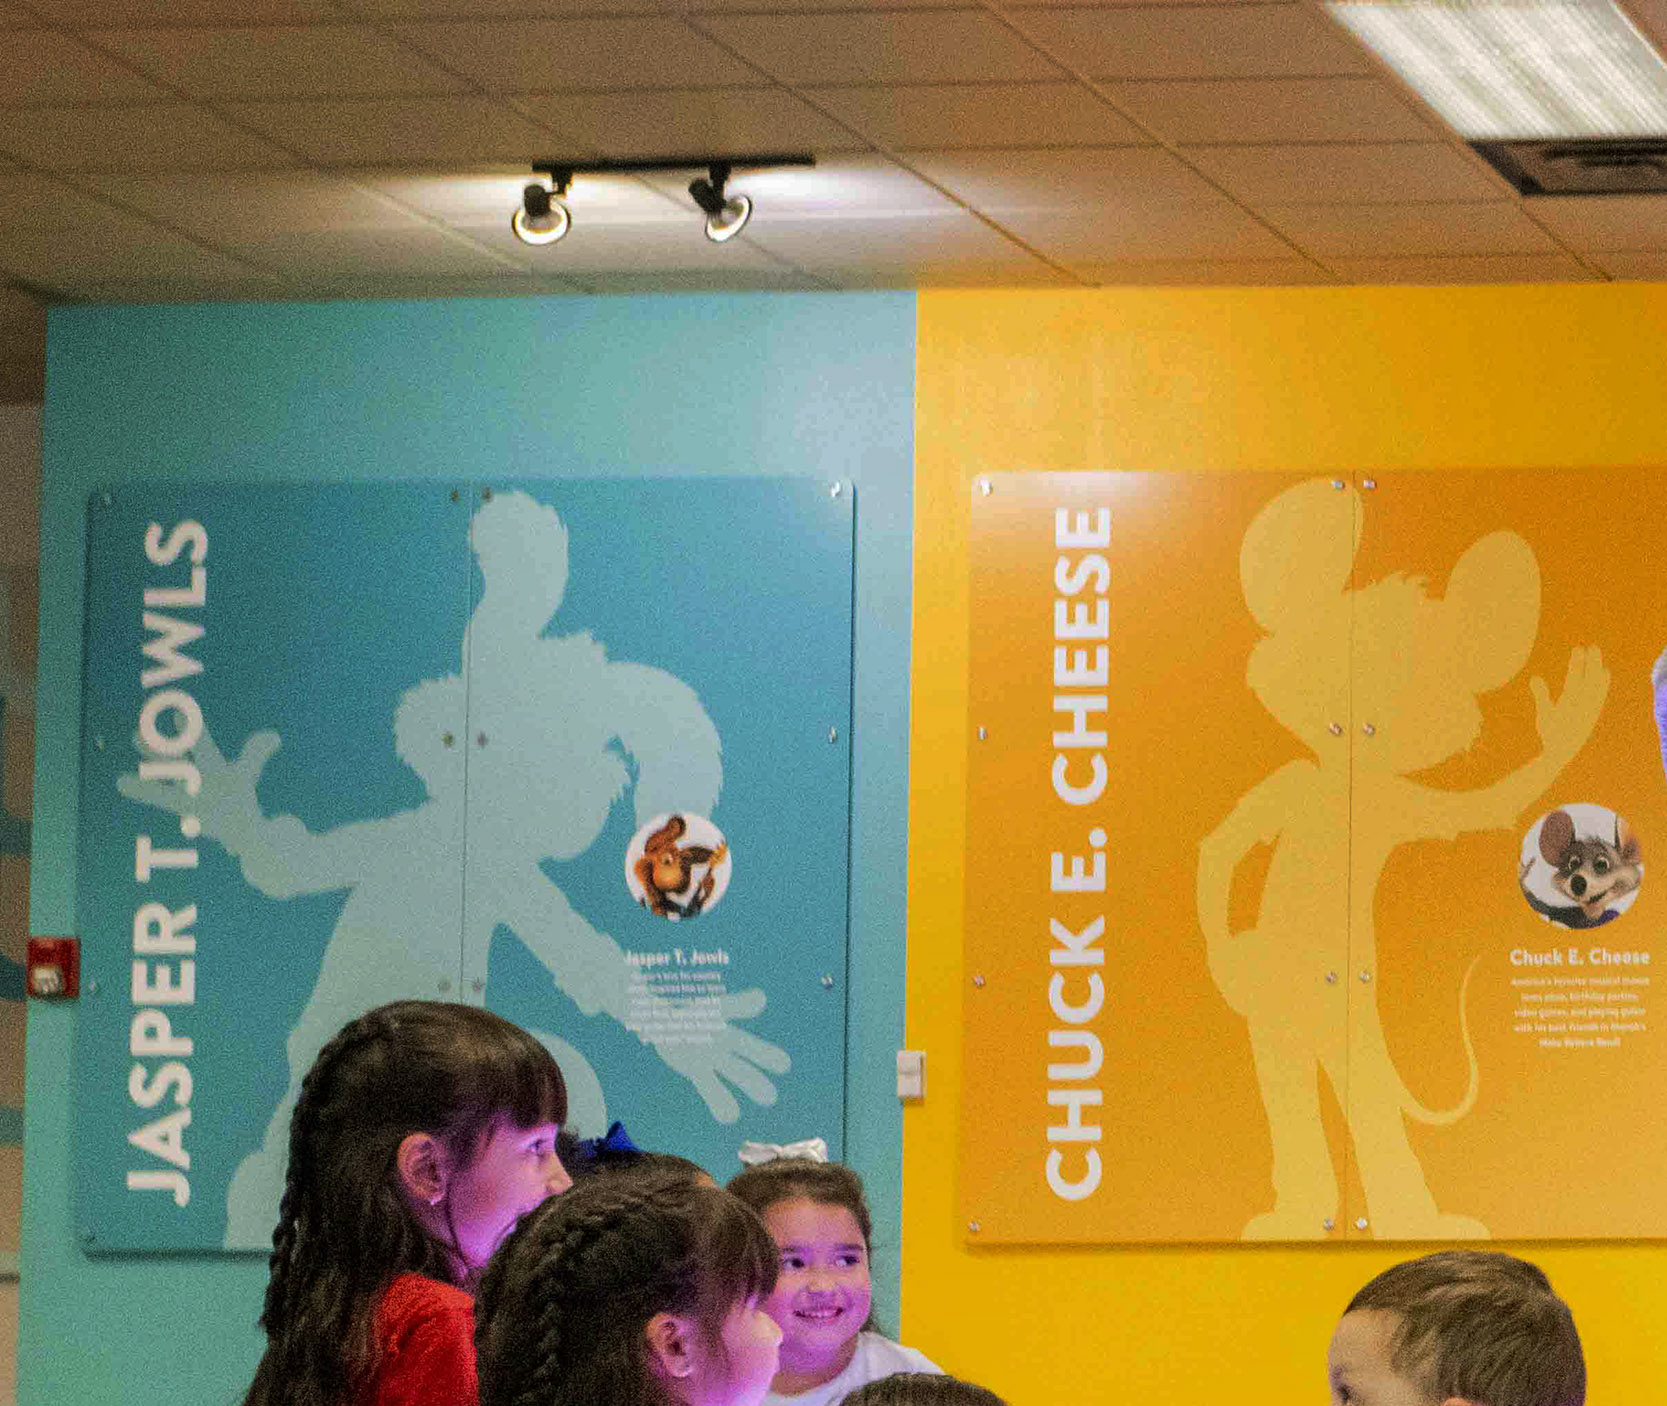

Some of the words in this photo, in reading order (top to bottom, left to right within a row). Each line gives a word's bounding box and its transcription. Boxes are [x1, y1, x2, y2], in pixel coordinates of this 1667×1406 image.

[139, 518, 208, 796] JOWLS
[1051, 505, 1111, 806] CHEESE
[135, 816, 200, 883] T.
[1050, 827, 1108, 892] E.
[1509, 948, 1562, 966] Chuck
[1568, 948, 1585, 966] E.
[1589, 948, 1651, 966] Cheese
[126, 902, 198, 1207] JASPER
[1045, 914, 1106, 1201] CHUCK
